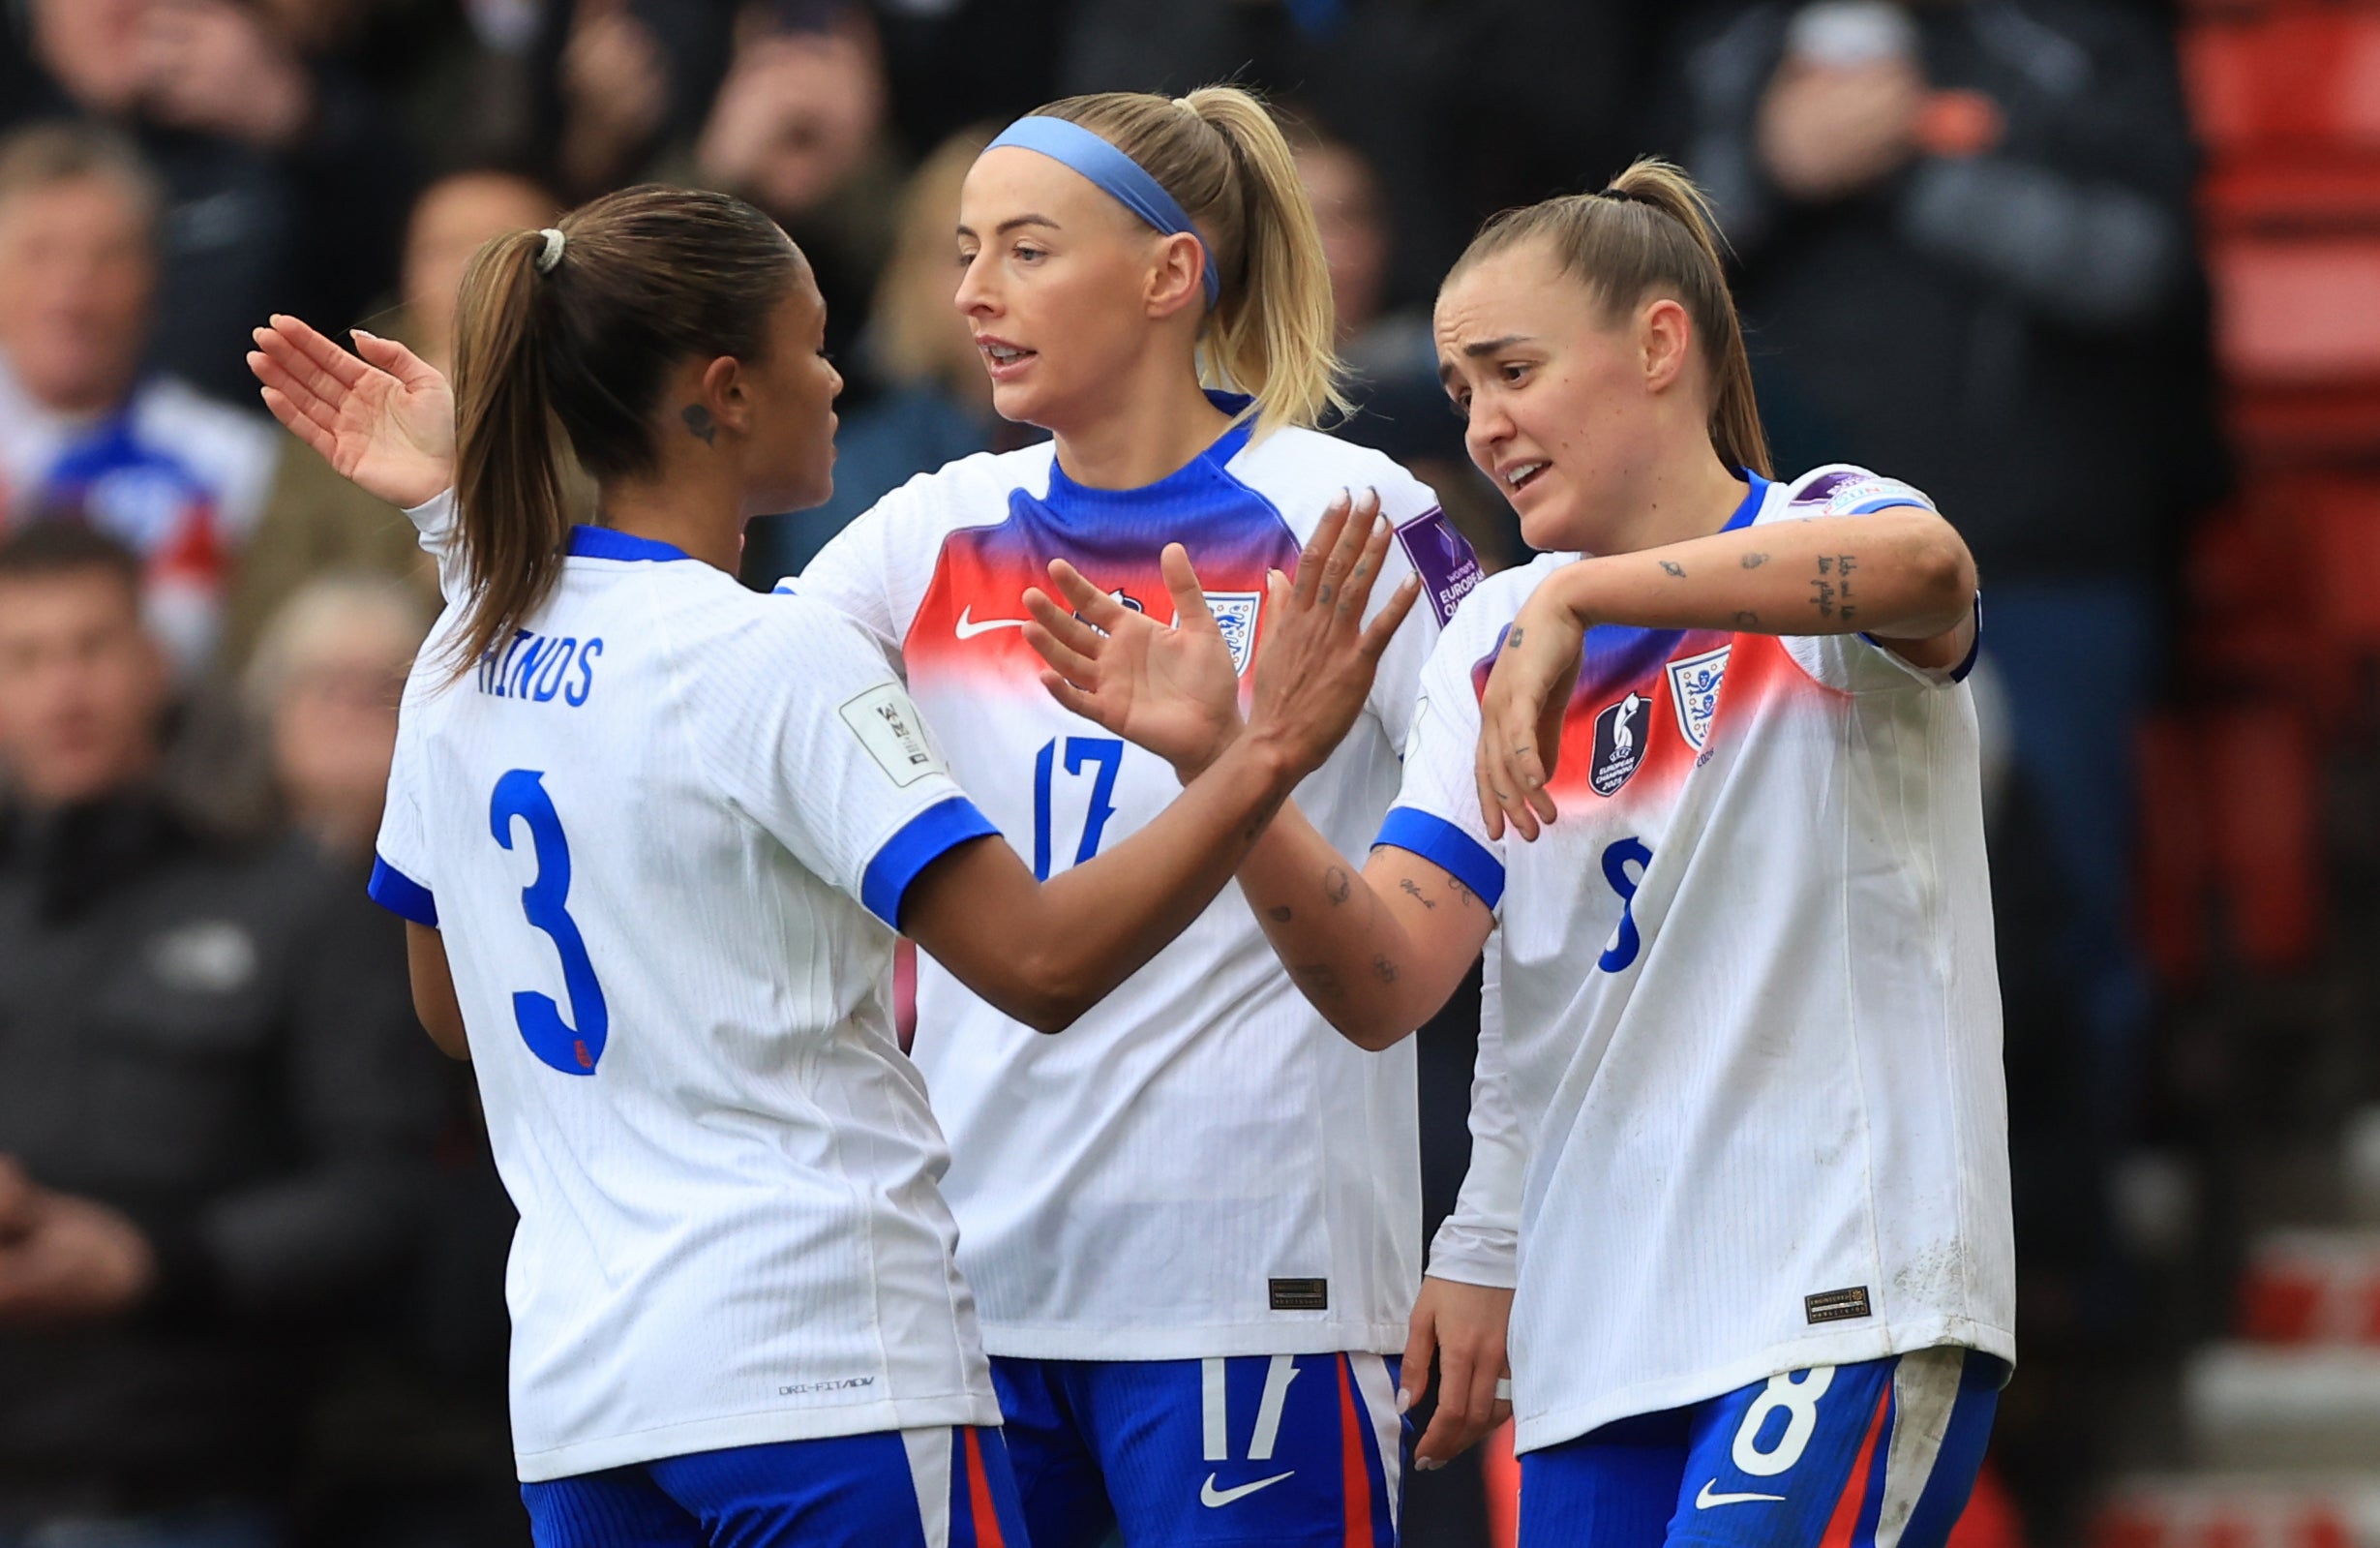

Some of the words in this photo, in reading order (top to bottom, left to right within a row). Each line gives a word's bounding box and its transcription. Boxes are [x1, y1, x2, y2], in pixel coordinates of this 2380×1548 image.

[1034, 736, 1124, 883] 17
[489, 769, 609, 1077] 3
[1732, 1365, 1835, 1476] 8
